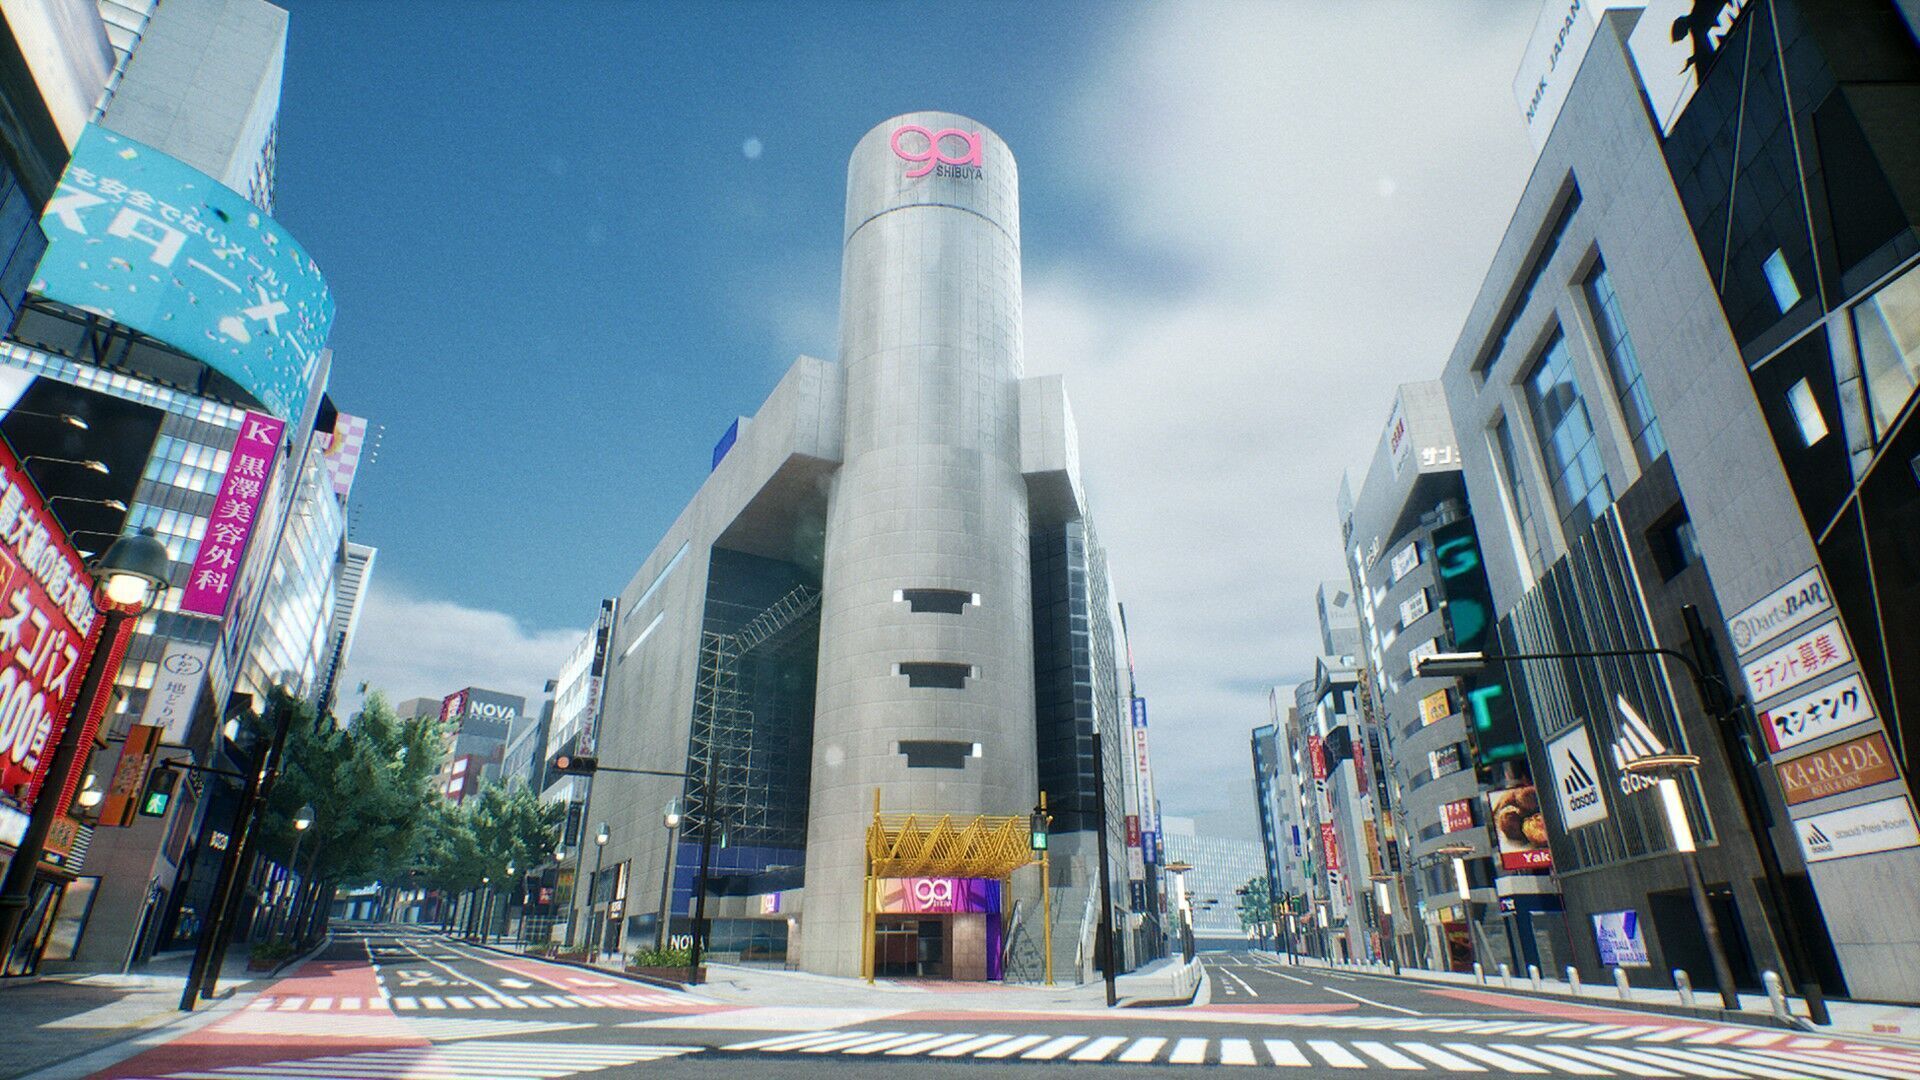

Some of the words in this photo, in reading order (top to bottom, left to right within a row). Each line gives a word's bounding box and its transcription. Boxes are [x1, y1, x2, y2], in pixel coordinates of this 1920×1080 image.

[1526, 74, 1548, 125] NMK
[1549, 0, 1583, 72] JAPAN
[936, 165, 983, 181] SHIBUYA
[244, 420, 278, 446] K
[195, 454, 266, 595] 黒澤美容外科
[1751, 634, 1839, 693] テナント募集
[470, 700, 516, 719] NOVA
[1775, 686, 1859, 740] スシキング
[1569, 787, 1599, 812] dasadi
